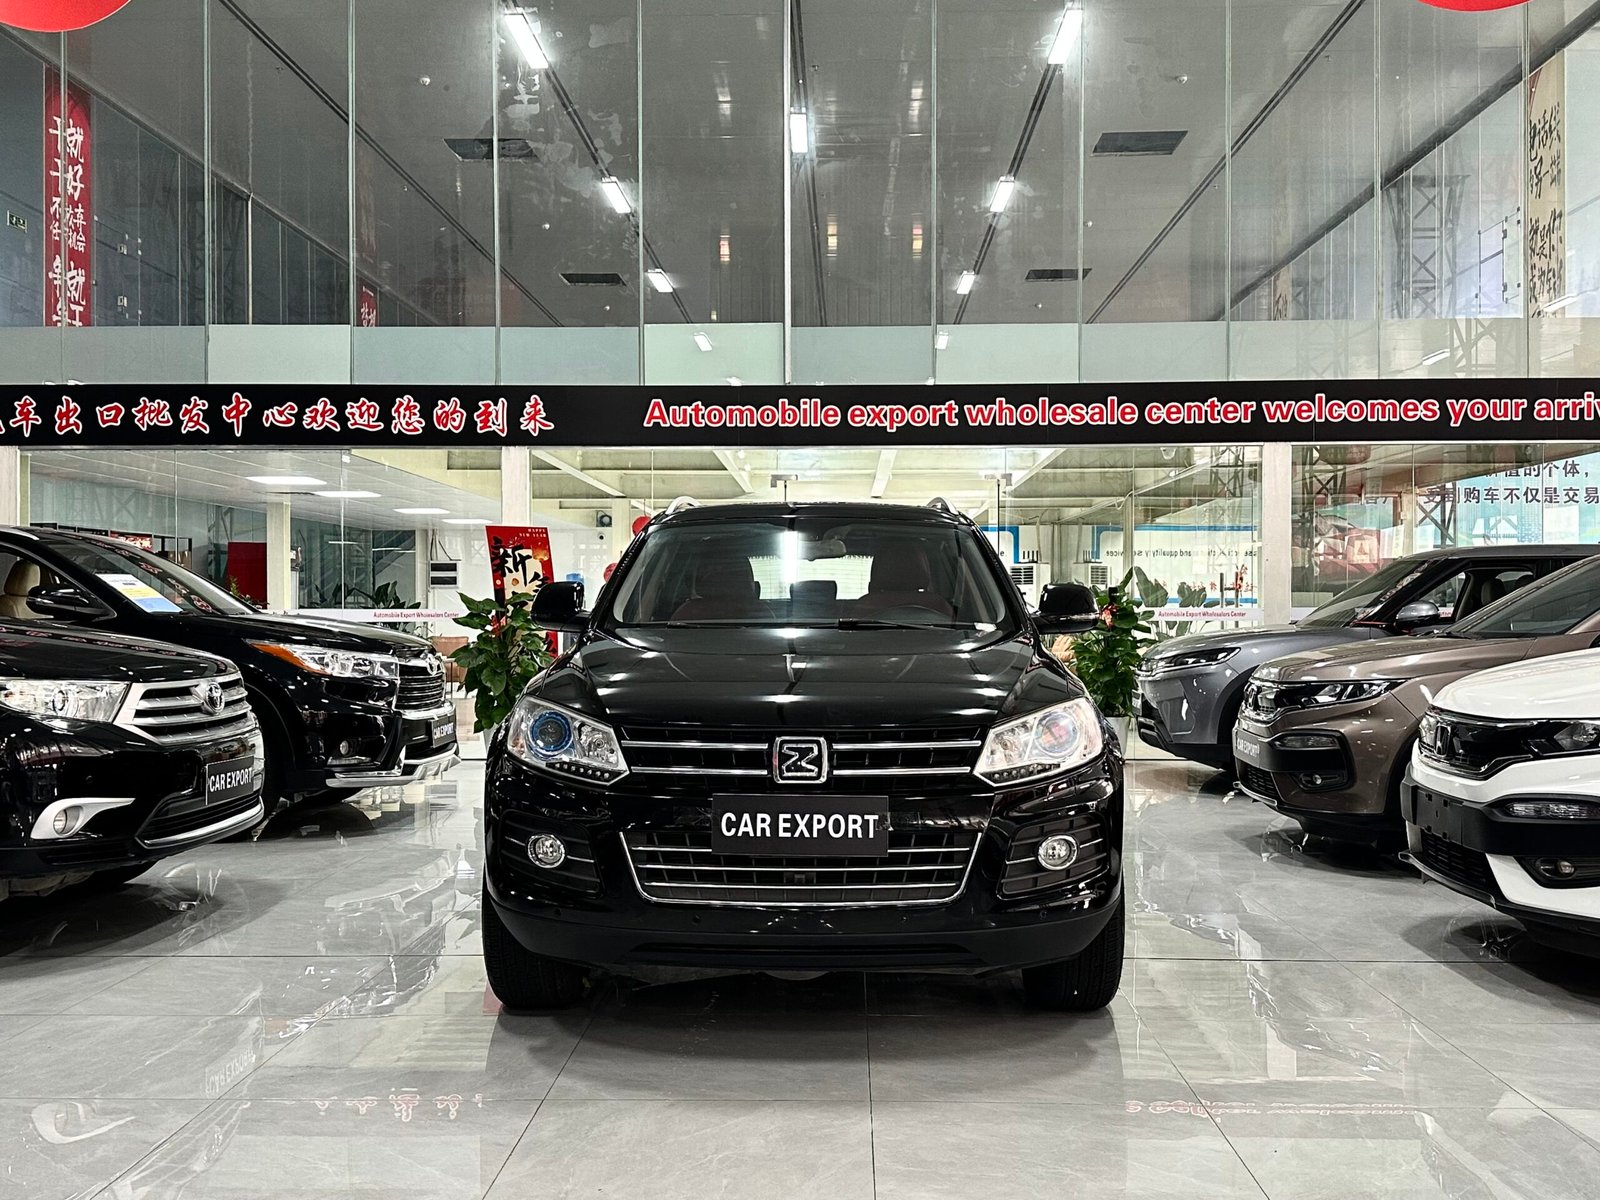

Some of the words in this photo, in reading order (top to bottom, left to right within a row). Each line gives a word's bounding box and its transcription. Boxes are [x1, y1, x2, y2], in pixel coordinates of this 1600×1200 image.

[0, 391, 555, 438] 车出口批发中心欢迎您的到来
[643, 398, 842, 428] Automobile
[848, 398, 959, 432] export
[964, 396, 1139, 427] wholesale
[1145, 397, 1257, 426] center
[1262, 393, 1441, 425] welcomes
[1446, 398, 1528, 427] your
[1533, 391, 1600, 421] arri
[400, 611, 416, 620] Export
[1185, 611, 1201, 619] Export
[209, 774, 226, 793] CAR
[226, 767, 253, 789] EXPORT
[721, 812, 772, 837] CAR
[778, 813, 879, 839] EXPORT
